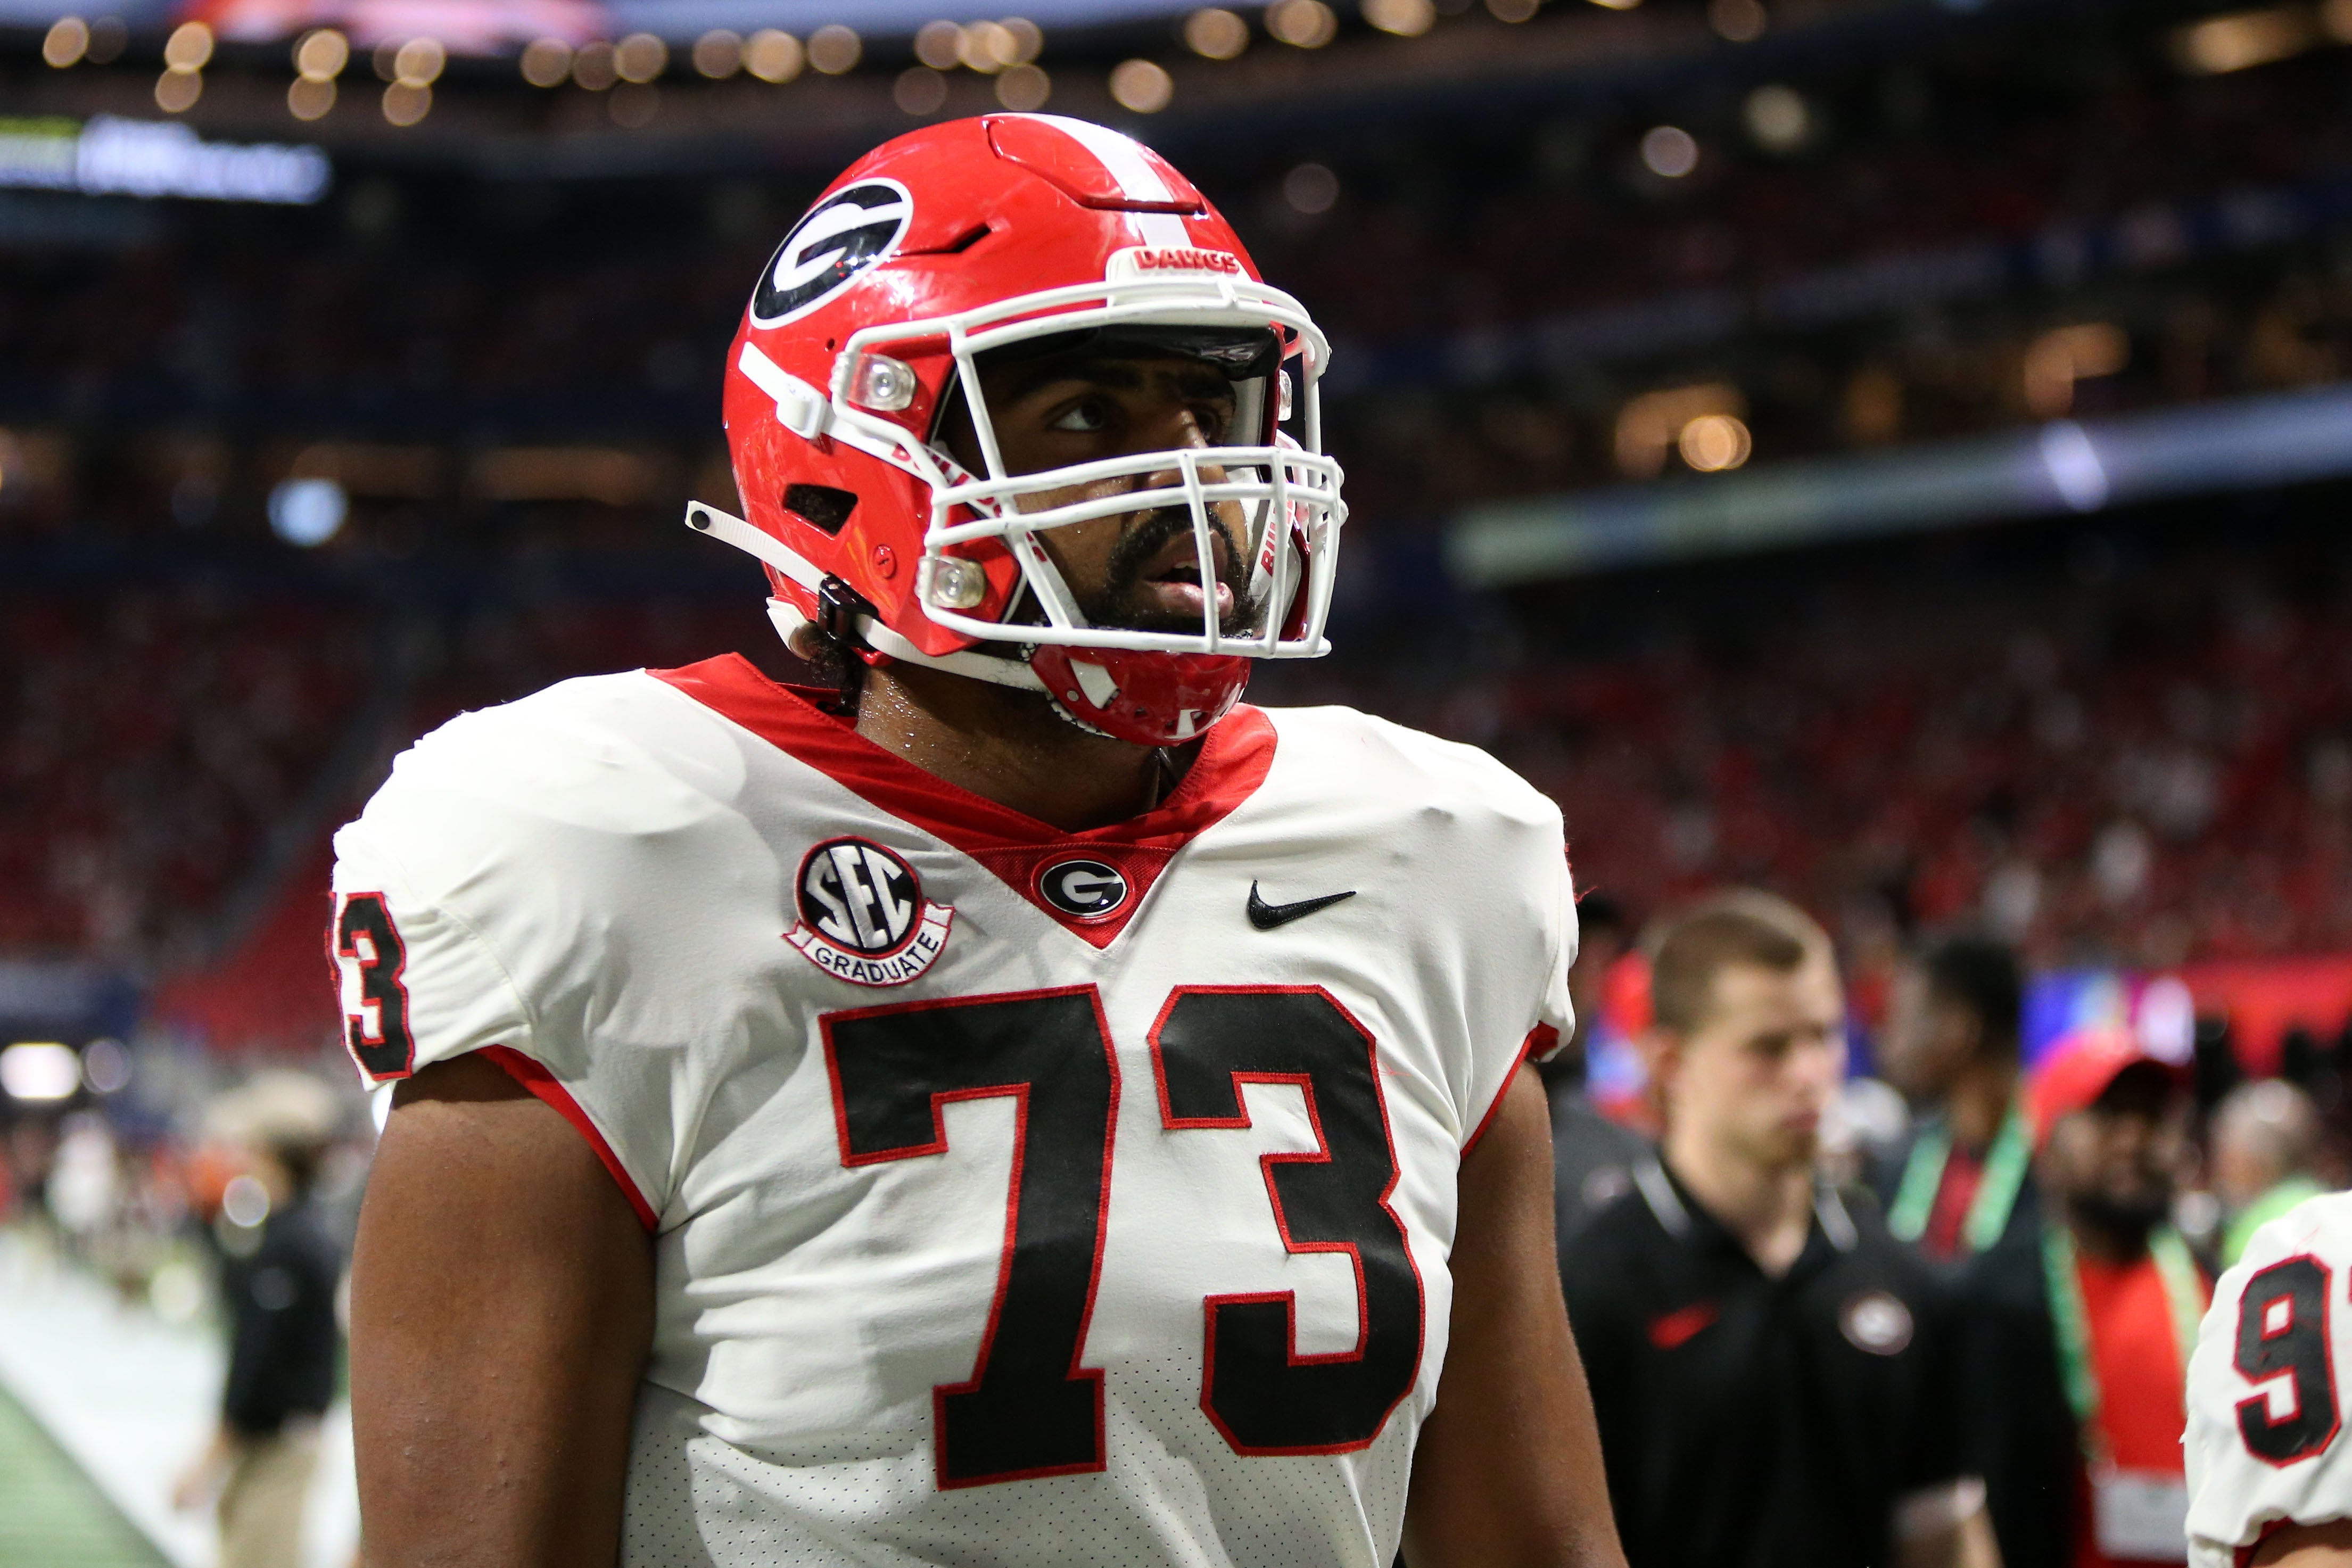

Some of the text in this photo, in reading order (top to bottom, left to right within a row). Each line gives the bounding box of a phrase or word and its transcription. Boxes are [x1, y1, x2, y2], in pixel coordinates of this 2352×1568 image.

[752, 181, 908, 325] G
[1133, 249, 1239, 274] DAWGS
[805, 845, 911, 948] SEC
[1042, 861, 1125, 915] G
[815, 931, 939, 983] GRADUATE
[818, 982, 1426, 1491] 73
[2233, 1253, 2352, 1468] 9
